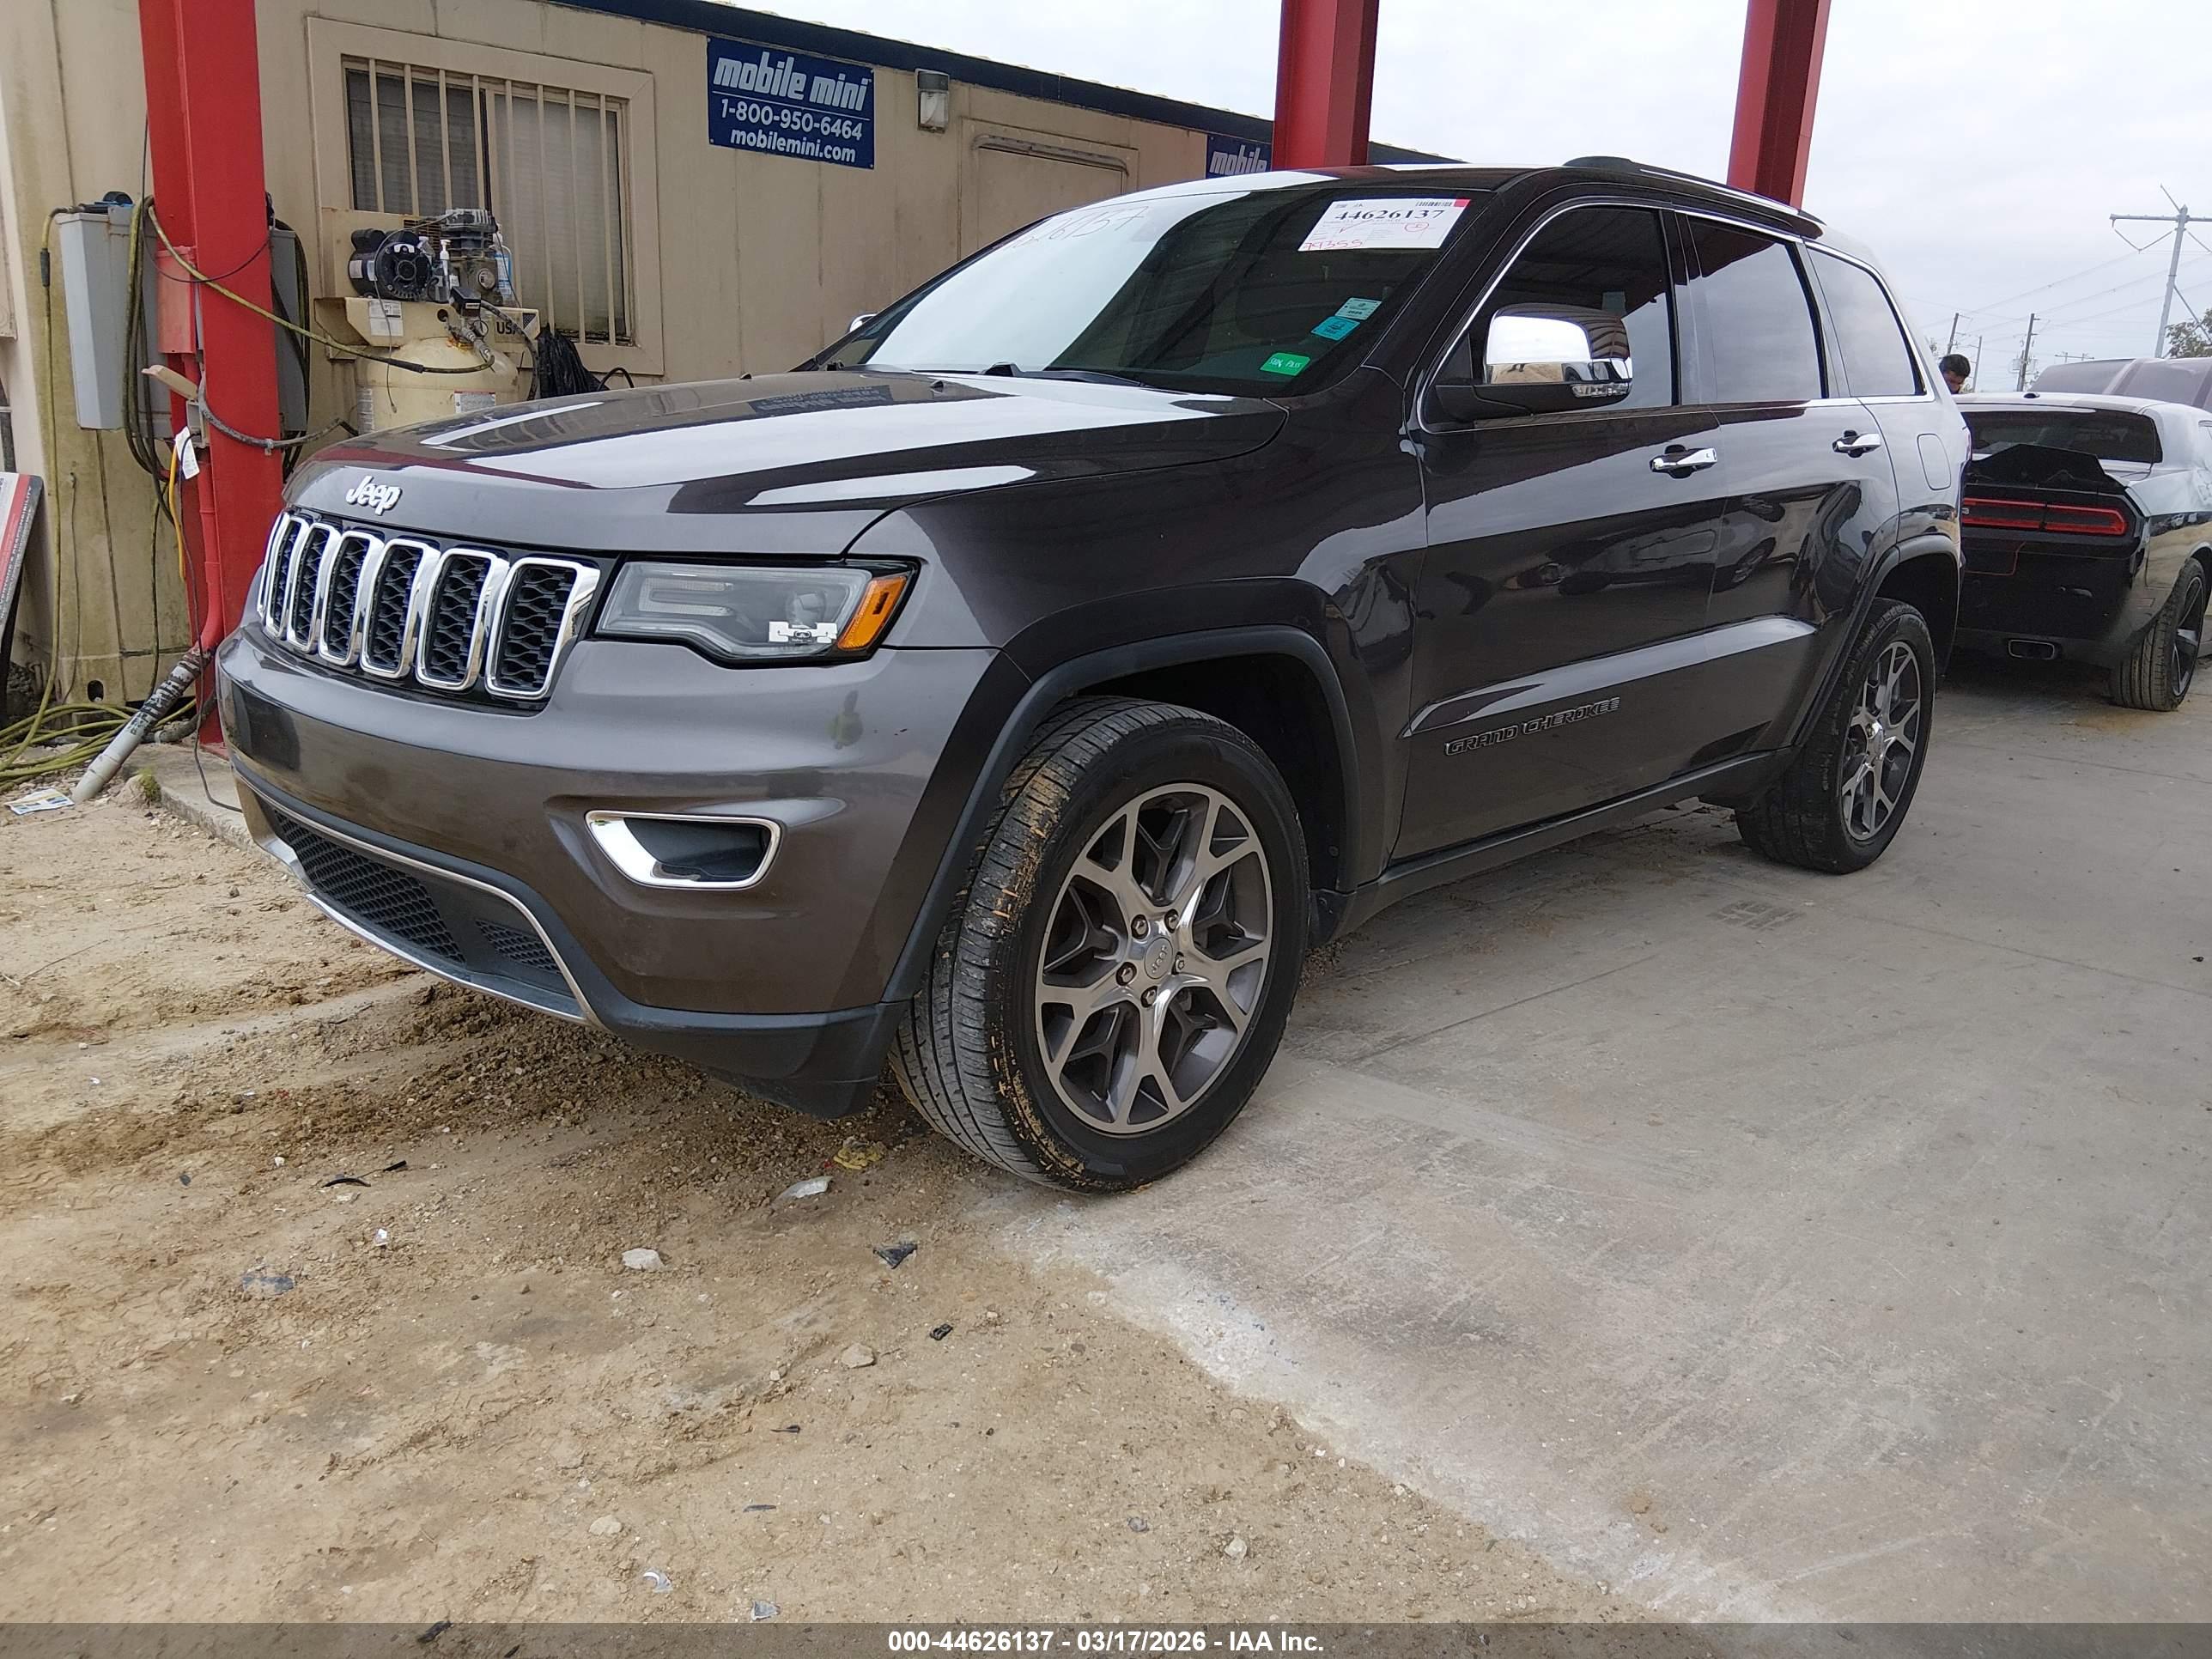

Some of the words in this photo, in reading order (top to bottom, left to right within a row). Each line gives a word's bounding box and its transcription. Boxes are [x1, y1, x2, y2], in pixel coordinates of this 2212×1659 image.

[714, 51, 807, 100] mobile
[809, 73, 867, 111] mini
[720, 98, 863, 141] 1-800-950-6464
[730, 128, 856, 163] mobilemini.com
[1209, 144, 1267, 175] mobile
[1334, 209, 1445, 221] 44626137
[496, 321, 518, 335] US
[346, 475, 402, 516] Jeep
[1443, 725, 1519, 756] GRAND
[1522, 696, 1620, 735] CHEROKEE
